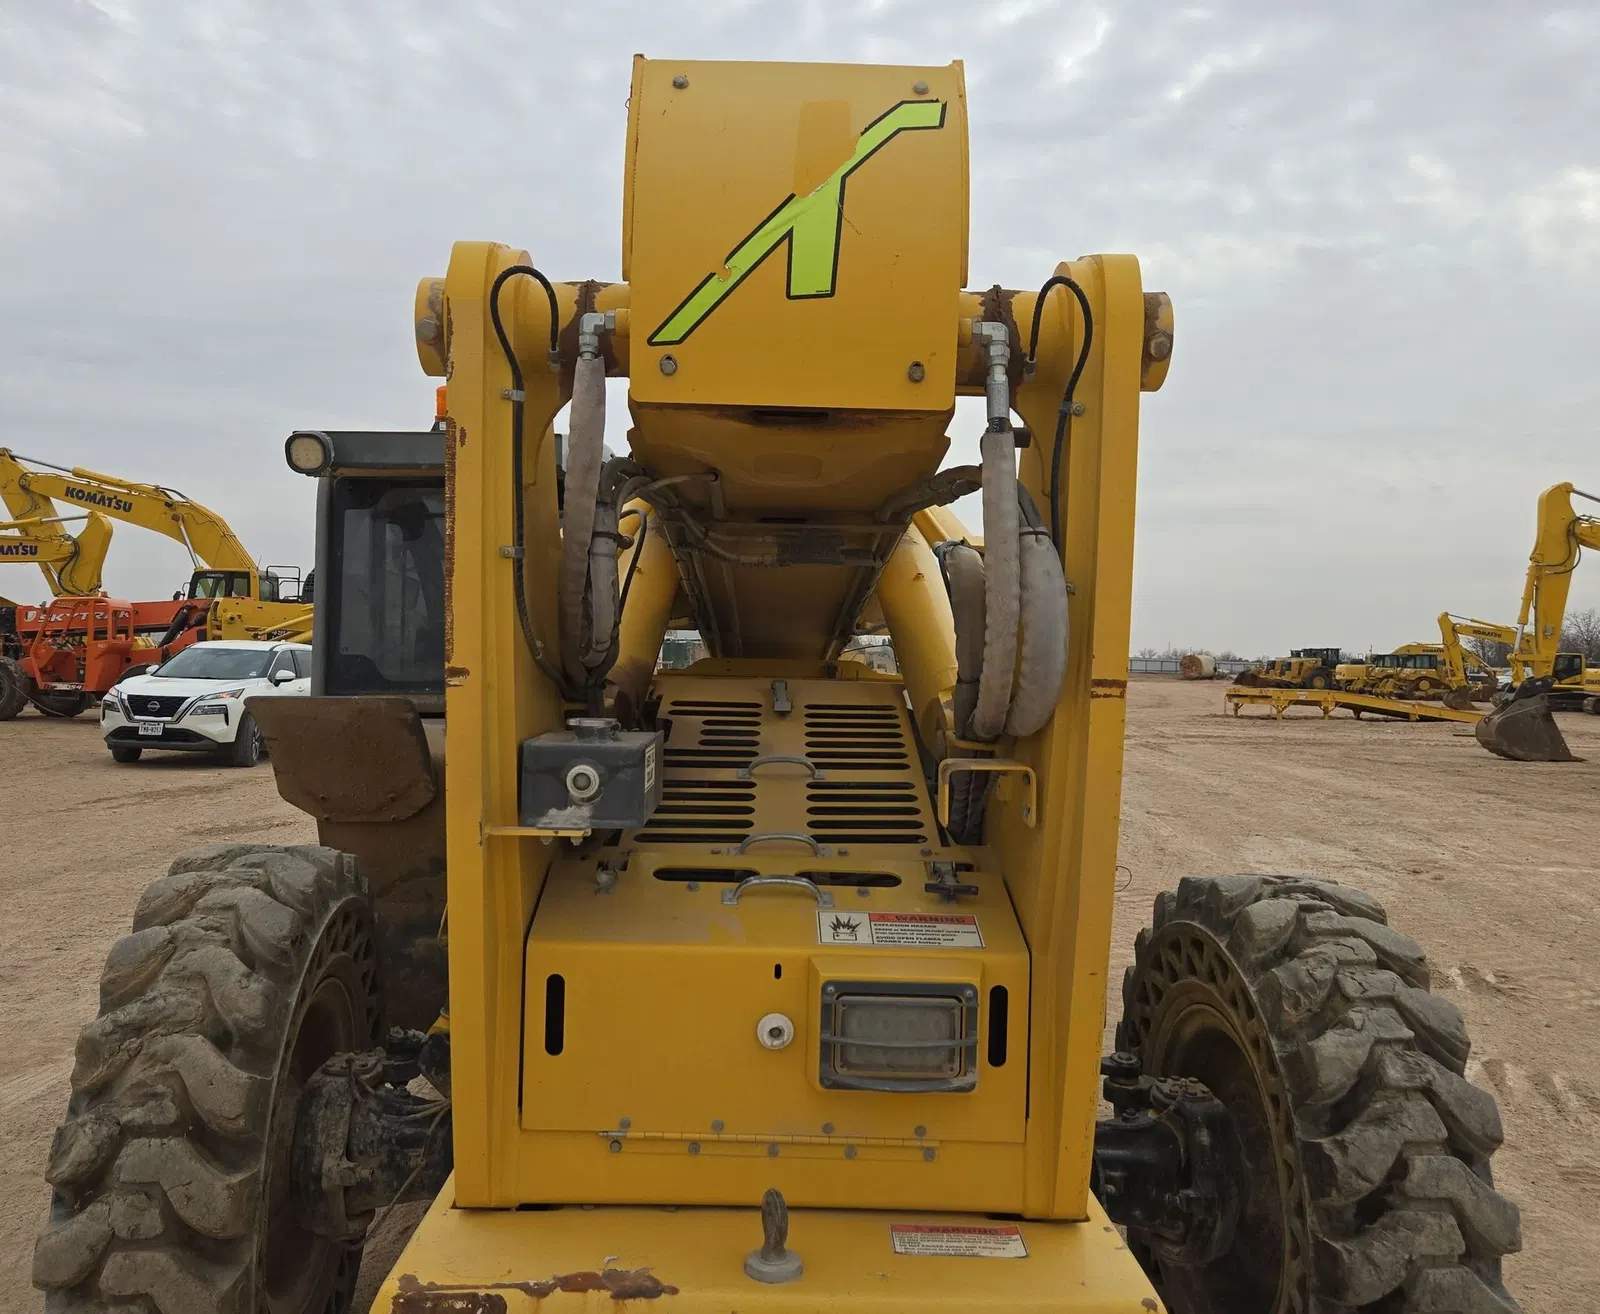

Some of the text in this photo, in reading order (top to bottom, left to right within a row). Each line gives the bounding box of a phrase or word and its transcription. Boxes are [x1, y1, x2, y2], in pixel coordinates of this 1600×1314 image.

[65, 486, 133, 513] KOMATSU
[38, 610, 130, 623] SKTRK
[1472, 629, 1503, 639] KOMATSU
[895, 915, 966, 923] WARNING
